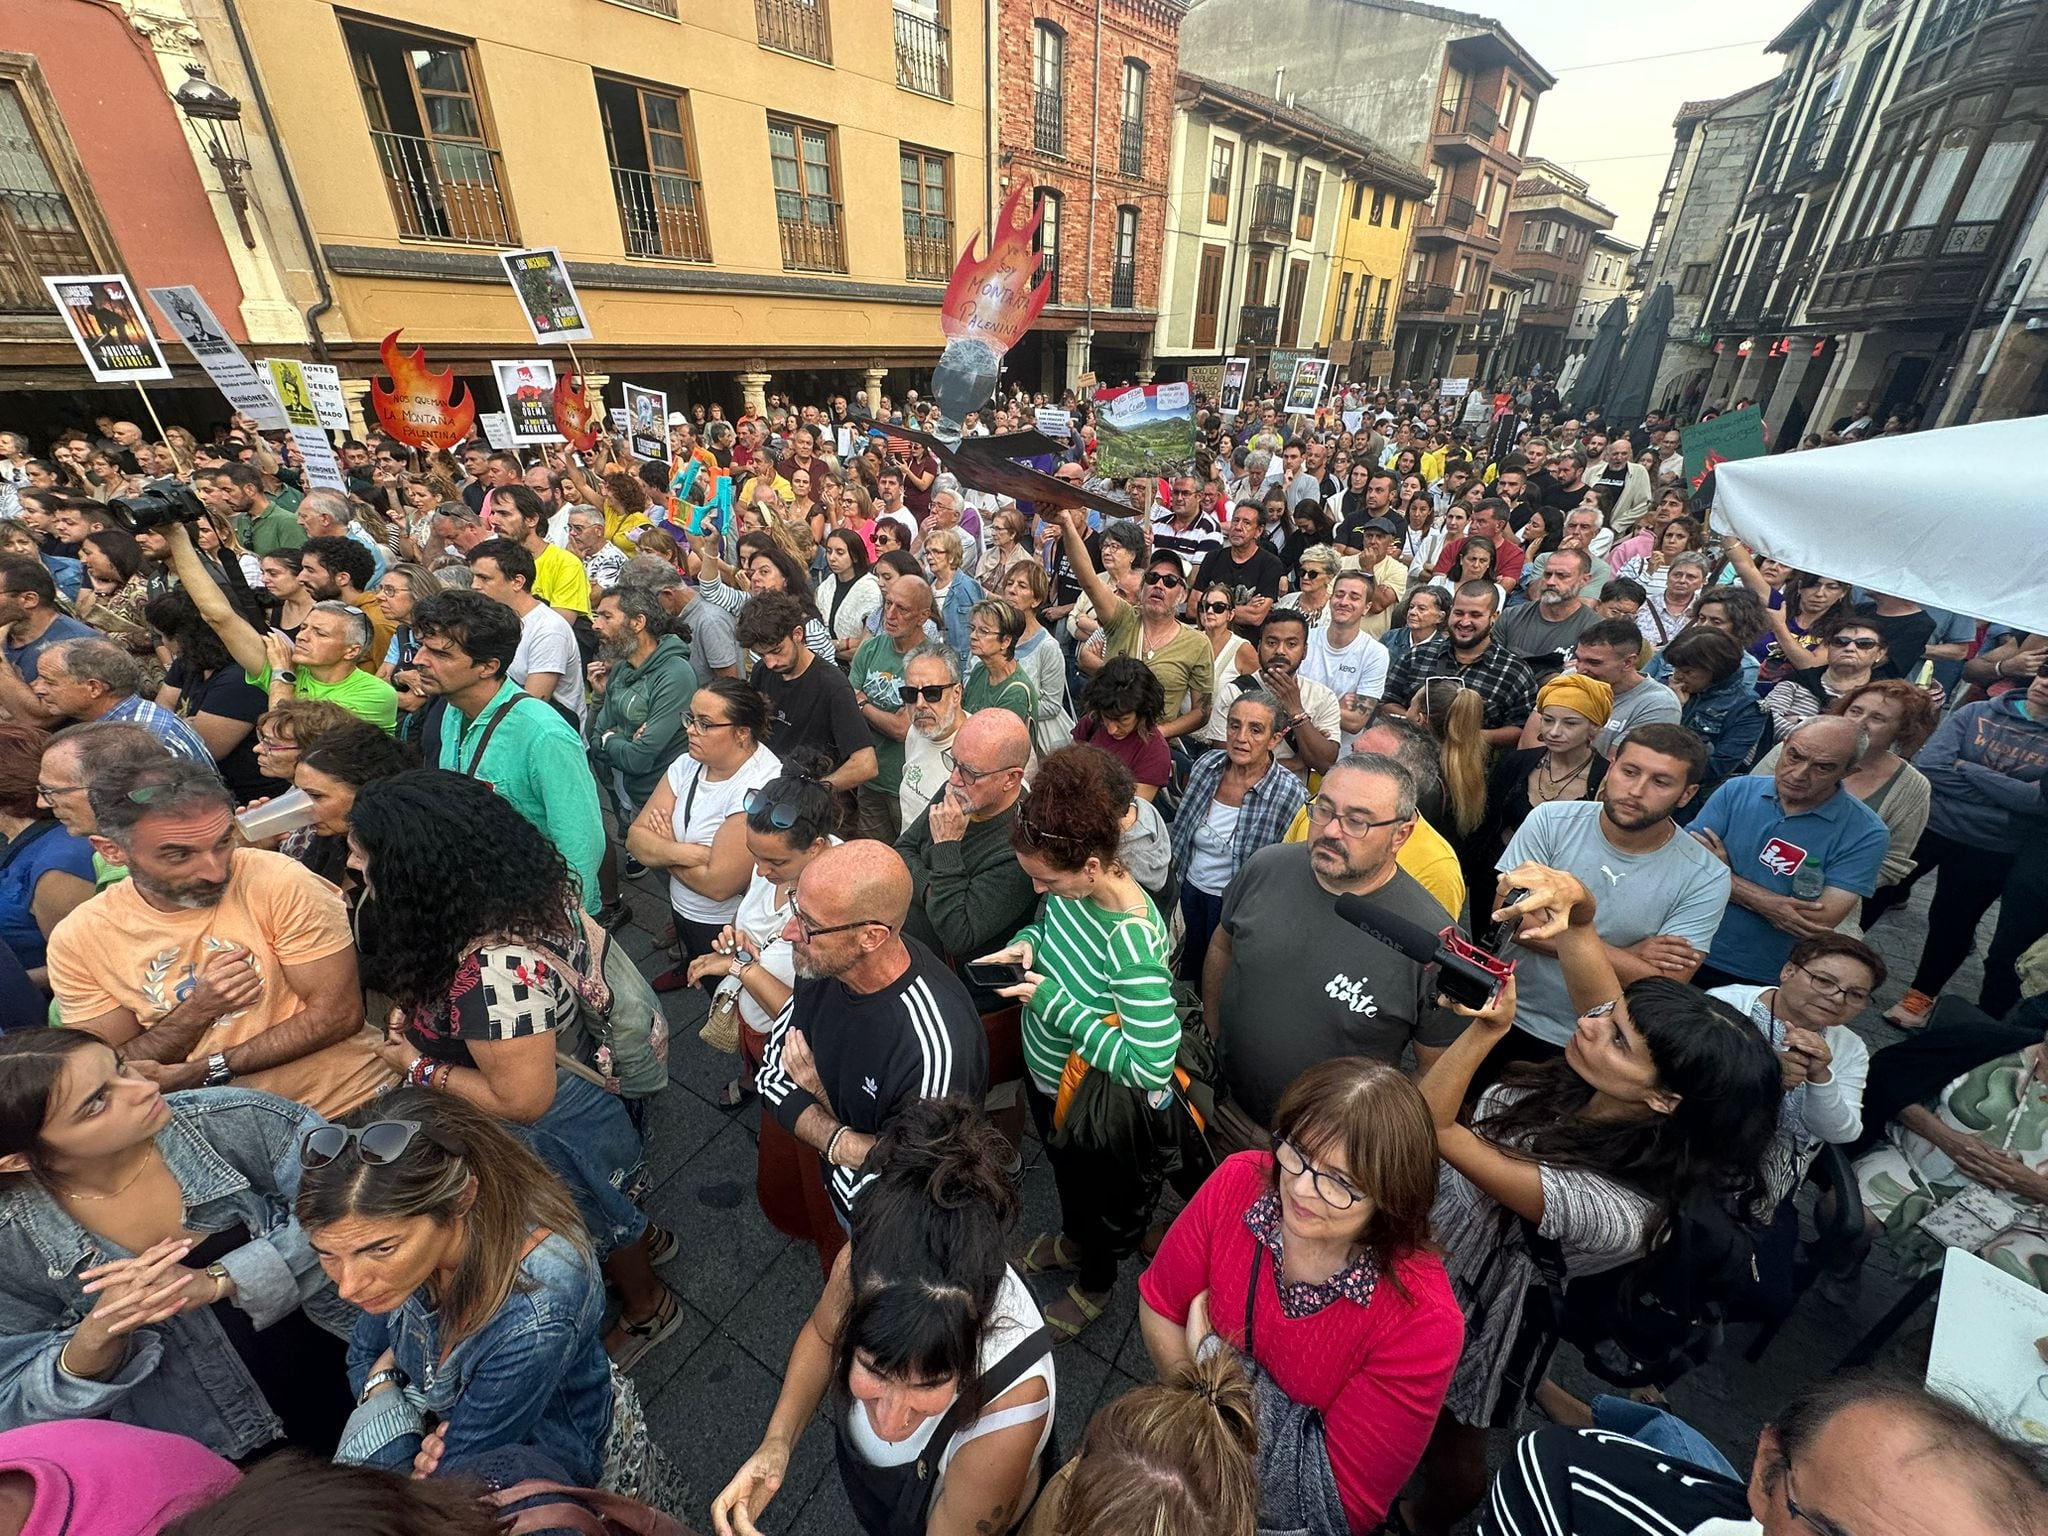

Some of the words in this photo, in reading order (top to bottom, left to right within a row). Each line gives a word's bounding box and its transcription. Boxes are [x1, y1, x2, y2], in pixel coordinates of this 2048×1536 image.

[111, 355, 152, 368] ESTABLES
[308, 382, 340, 391] UEBLOS
[393, 395, 410, 404] NOS
[415, 396, 448, 407] QUEMAN
[384, 408, 397, 420] LA
[522, 408, 547, 417] QUEMA
[402, 426, 457, 440] PALENTINA
[519, 424, 558, 433] PROBLEMA
[1974, 734, 2047, 767] WILDLIFE
[1333, 973, 1369, 994] mi
[1324, 980, 1378, 1018] norte
